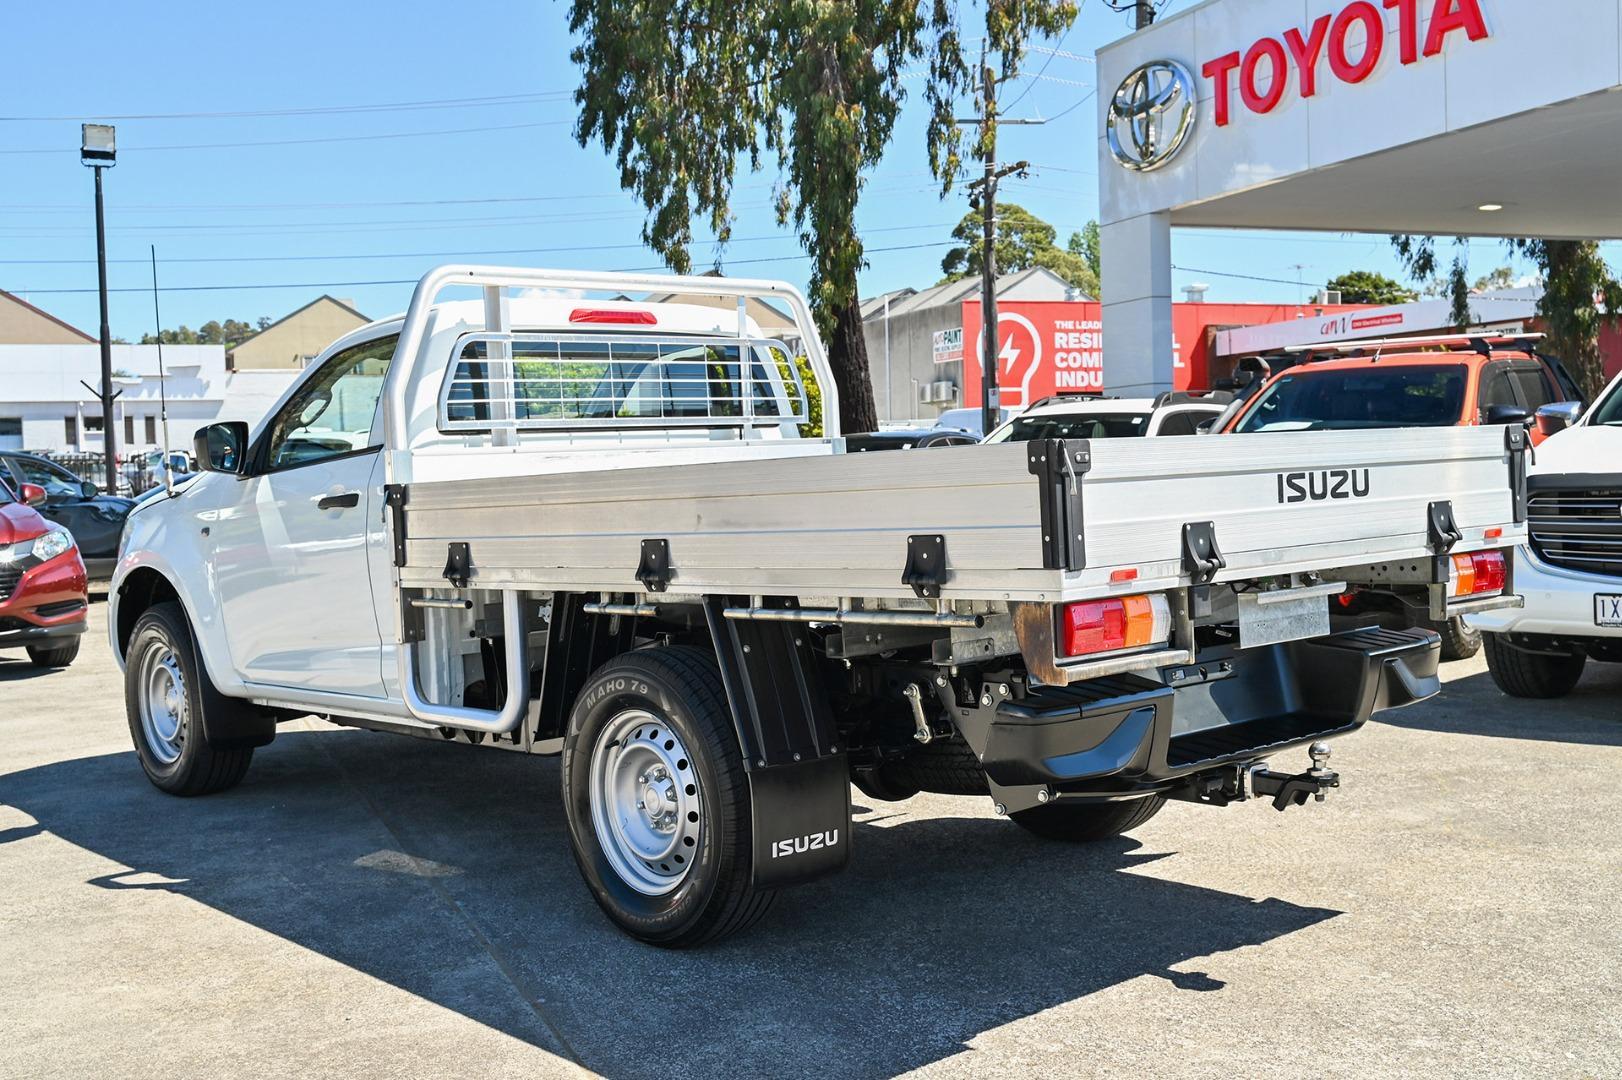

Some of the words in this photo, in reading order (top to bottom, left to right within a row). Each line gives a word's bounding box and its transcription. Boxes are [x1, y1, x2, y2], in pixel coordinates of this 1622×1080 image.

[1202, 0, 1488, 127] TOYOTA
[1055, 321, 1074, 329] THE
[1054, 332, 1102, 349] RESI
[1277, 469, 1369, 503] ISUZU
[586, 679, 625, 709] MAHO
[631, 680, 648, 694] 79
[772, 829, 838, 858] ISUZU
